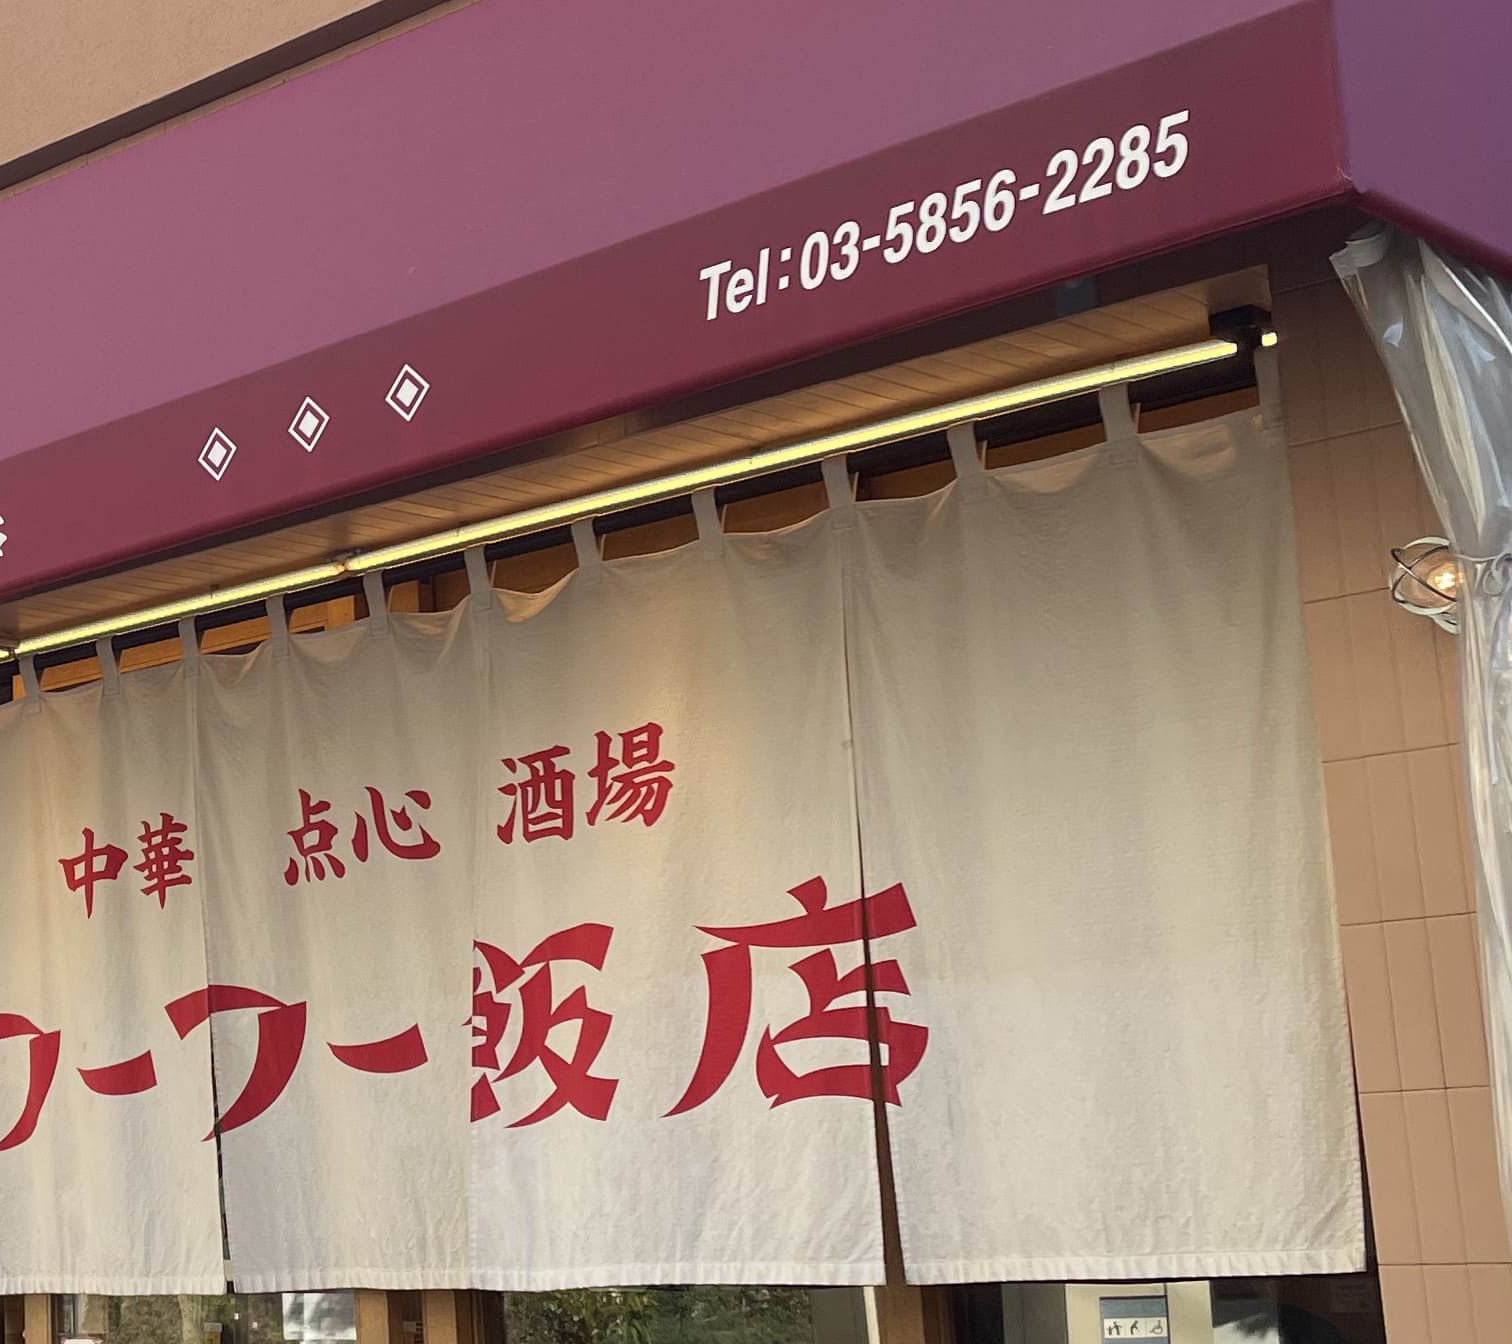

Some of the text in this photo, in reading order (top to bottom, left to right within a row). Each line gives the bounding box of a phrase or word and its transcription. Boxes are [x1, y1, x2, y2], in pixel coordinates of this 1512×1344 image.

[57, 721, 676, 920] 中華 点心 酒場
